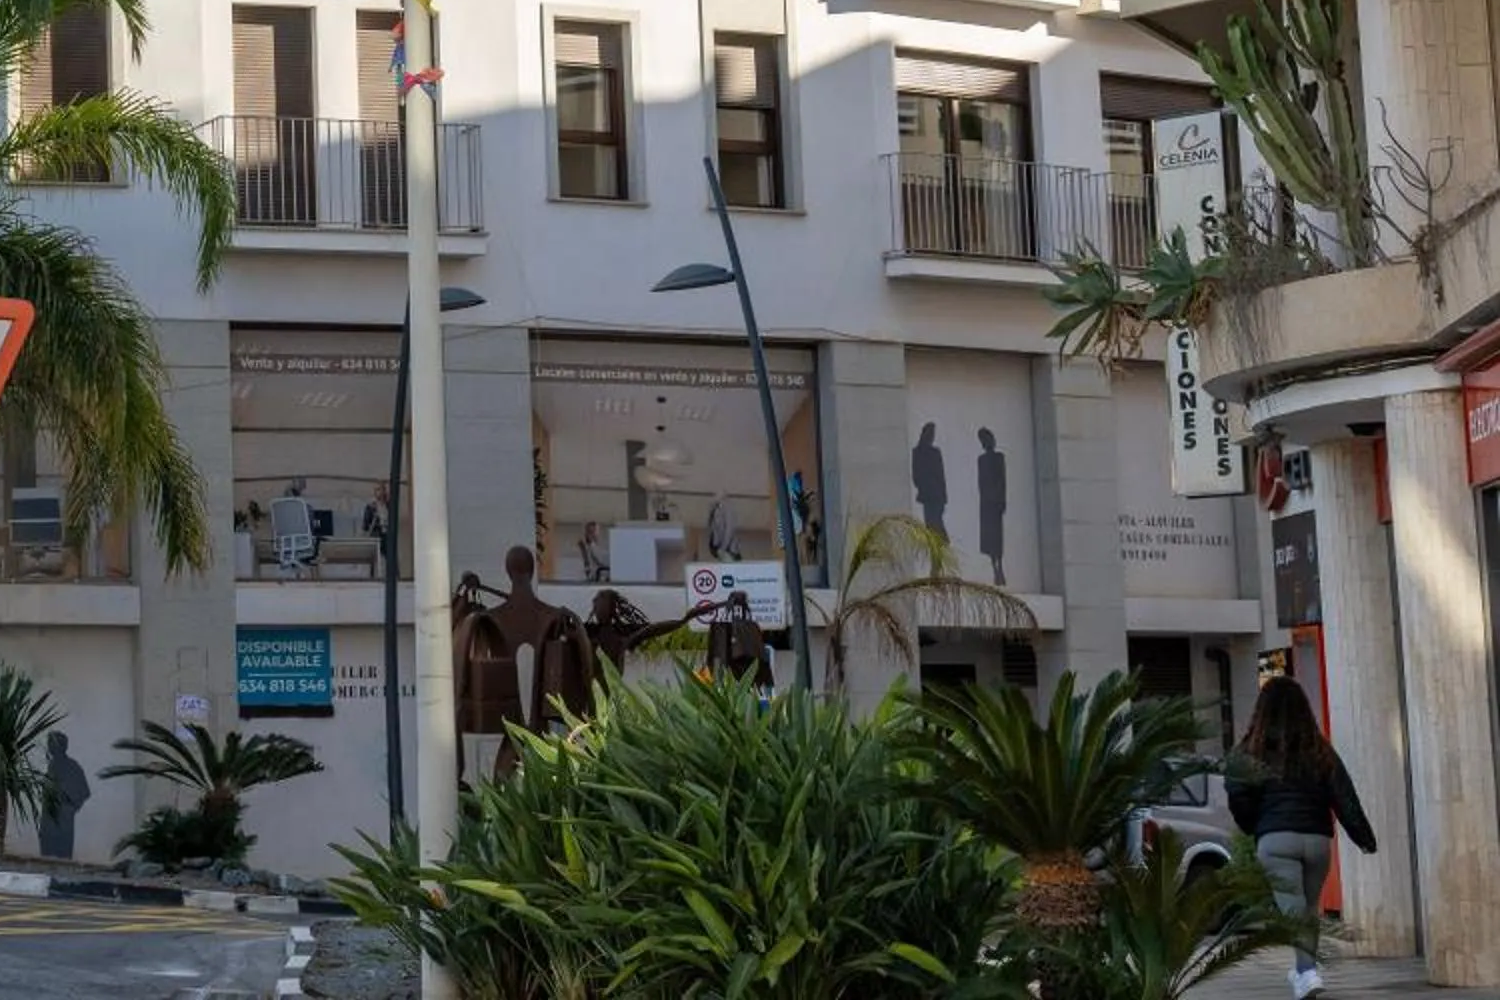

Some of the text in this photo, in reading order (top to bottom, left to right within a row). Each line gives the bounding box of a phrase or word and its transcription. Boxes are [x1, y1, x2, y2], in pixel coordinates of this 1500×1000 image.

[1160, 147, 1218, 167] CELENIA
[240, 356, 274, 369] Venta
[287, 357, 330, 371] alquiler
[698, 576, 713, 587] 20
[238, 640, 325, 653] DISPONIBLE
[241, 655, 322, 668] AVAILABLE
[238, 678, 327, 694] 634 818 546
